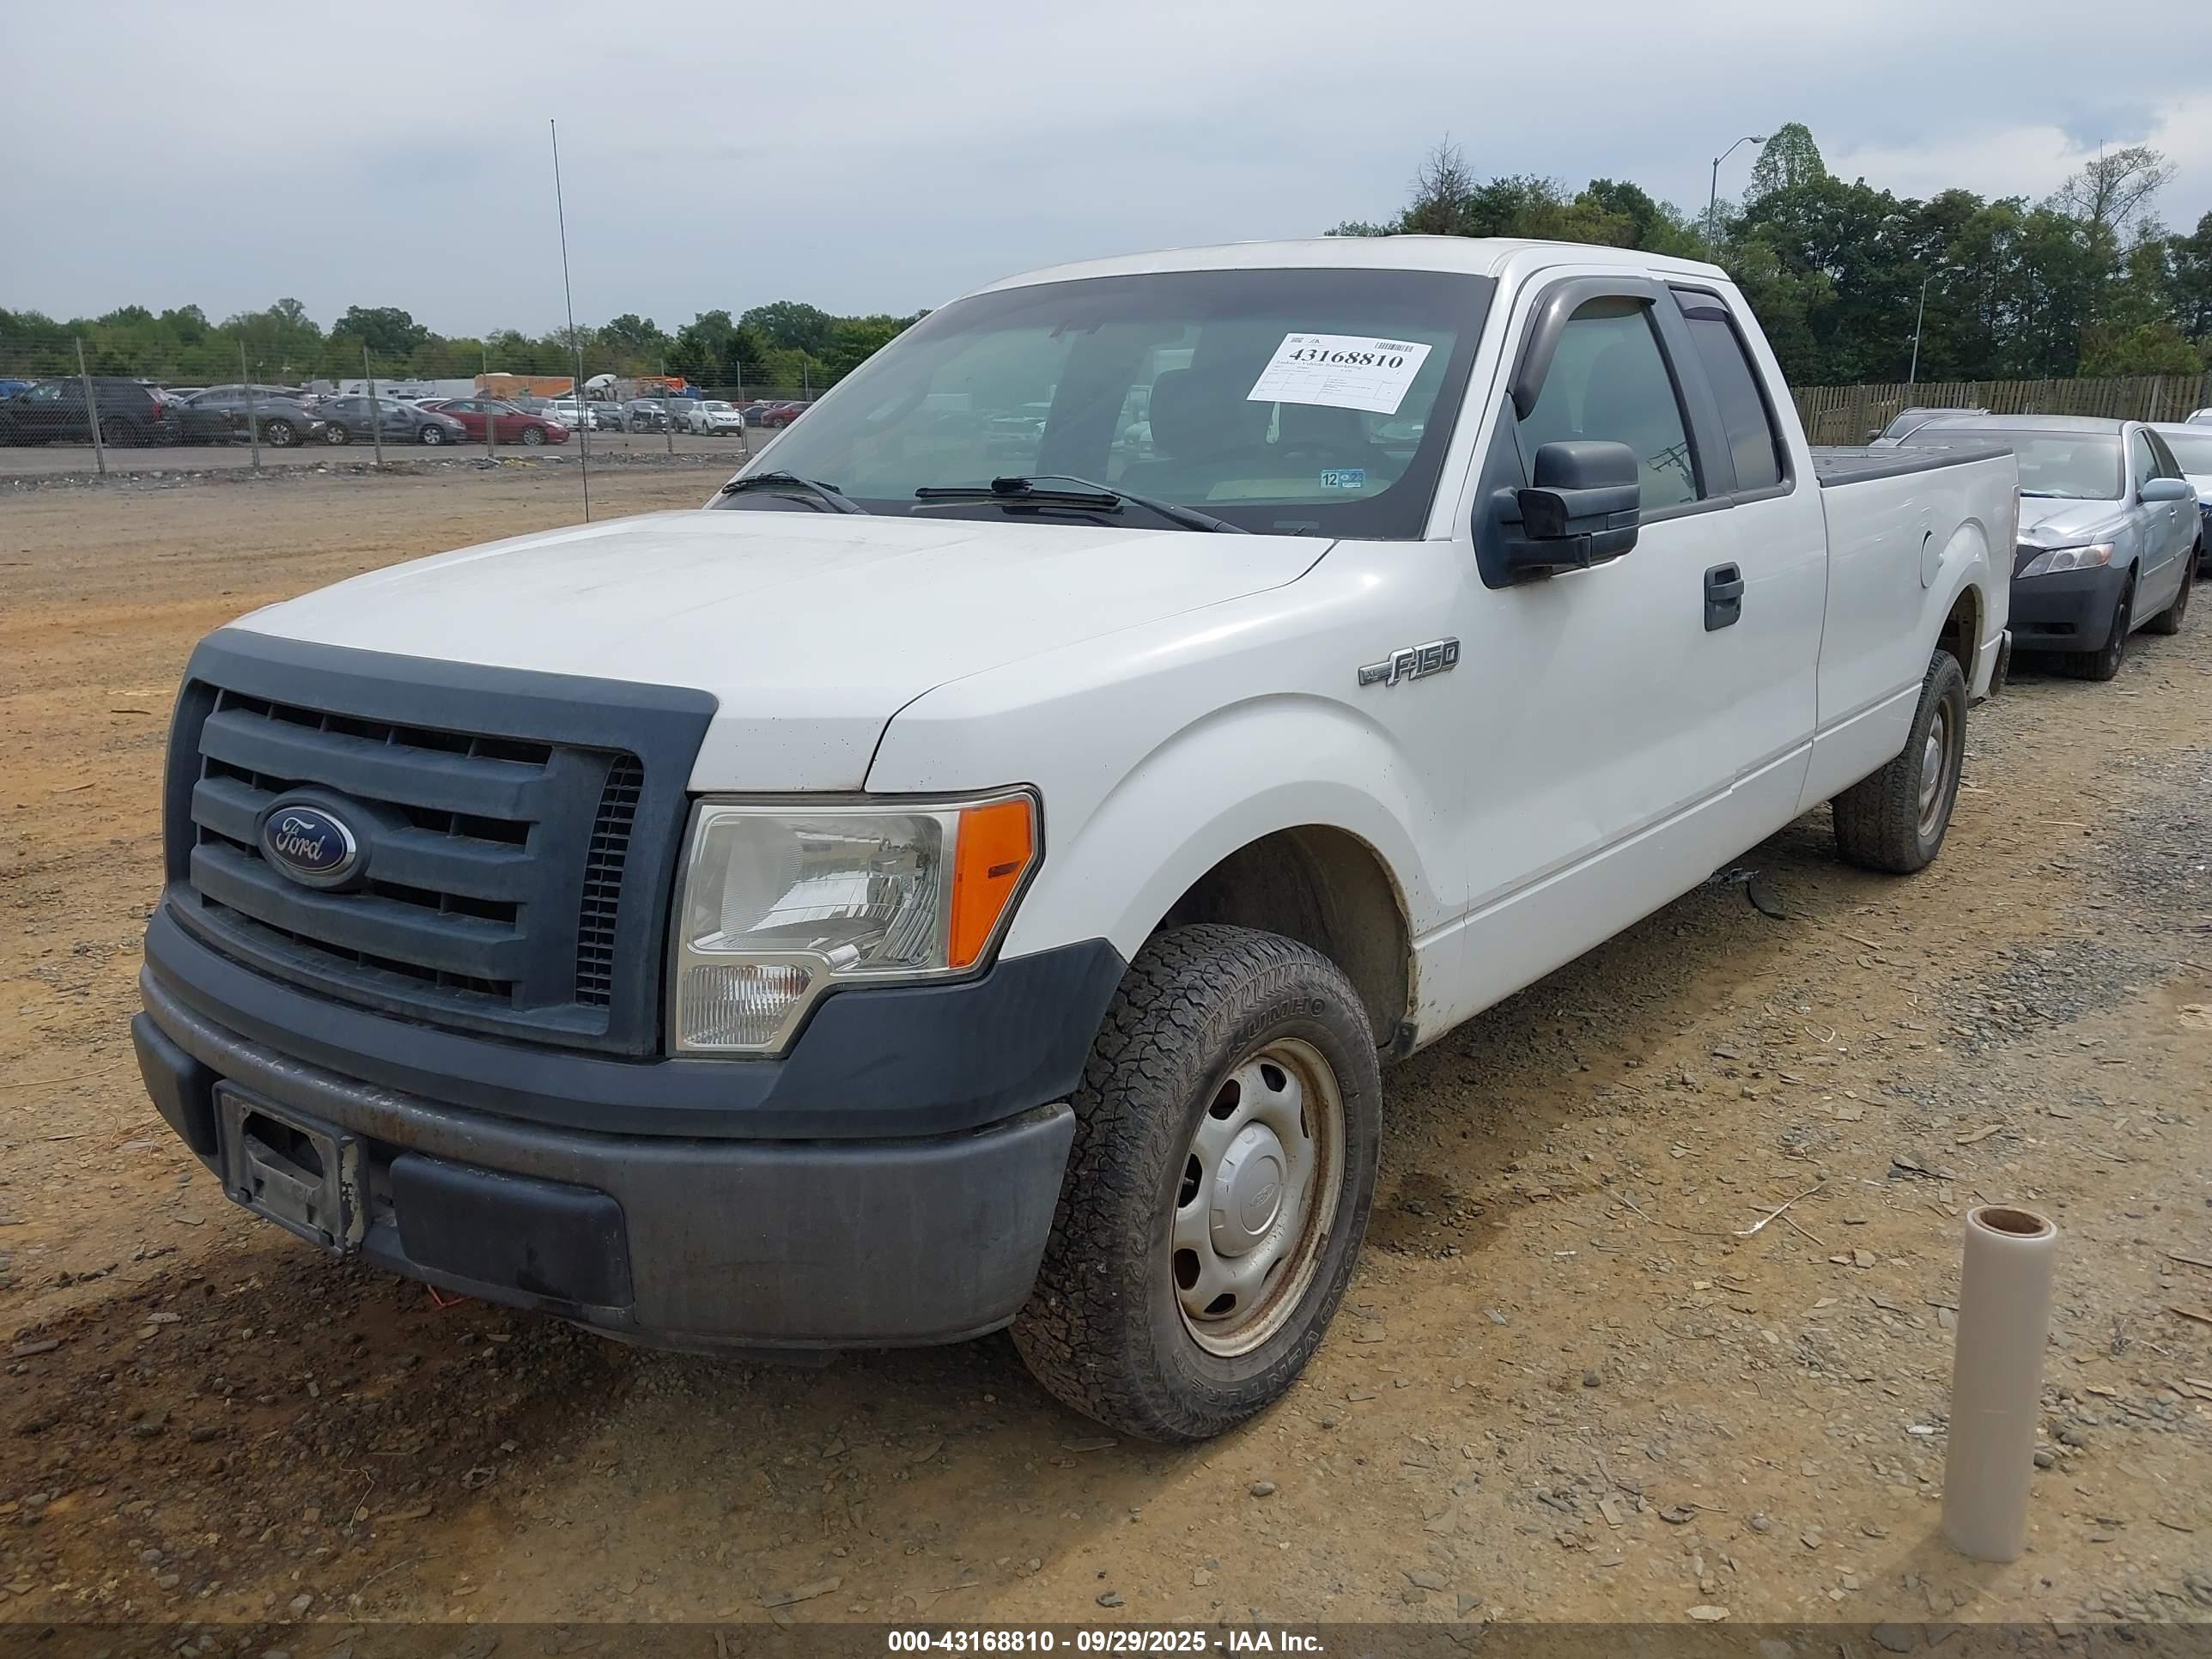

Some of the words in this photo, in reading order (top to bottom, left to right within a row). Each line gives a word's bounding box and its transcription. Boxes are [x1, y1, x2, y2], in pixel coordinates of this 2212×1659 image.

[1290, 348, 1403, 369] 43168810
[1322, 473, 1337, 486] 12
[276, 817, 325, 861] Ford
[1226, 996, 1326, 1064] KUMHO
